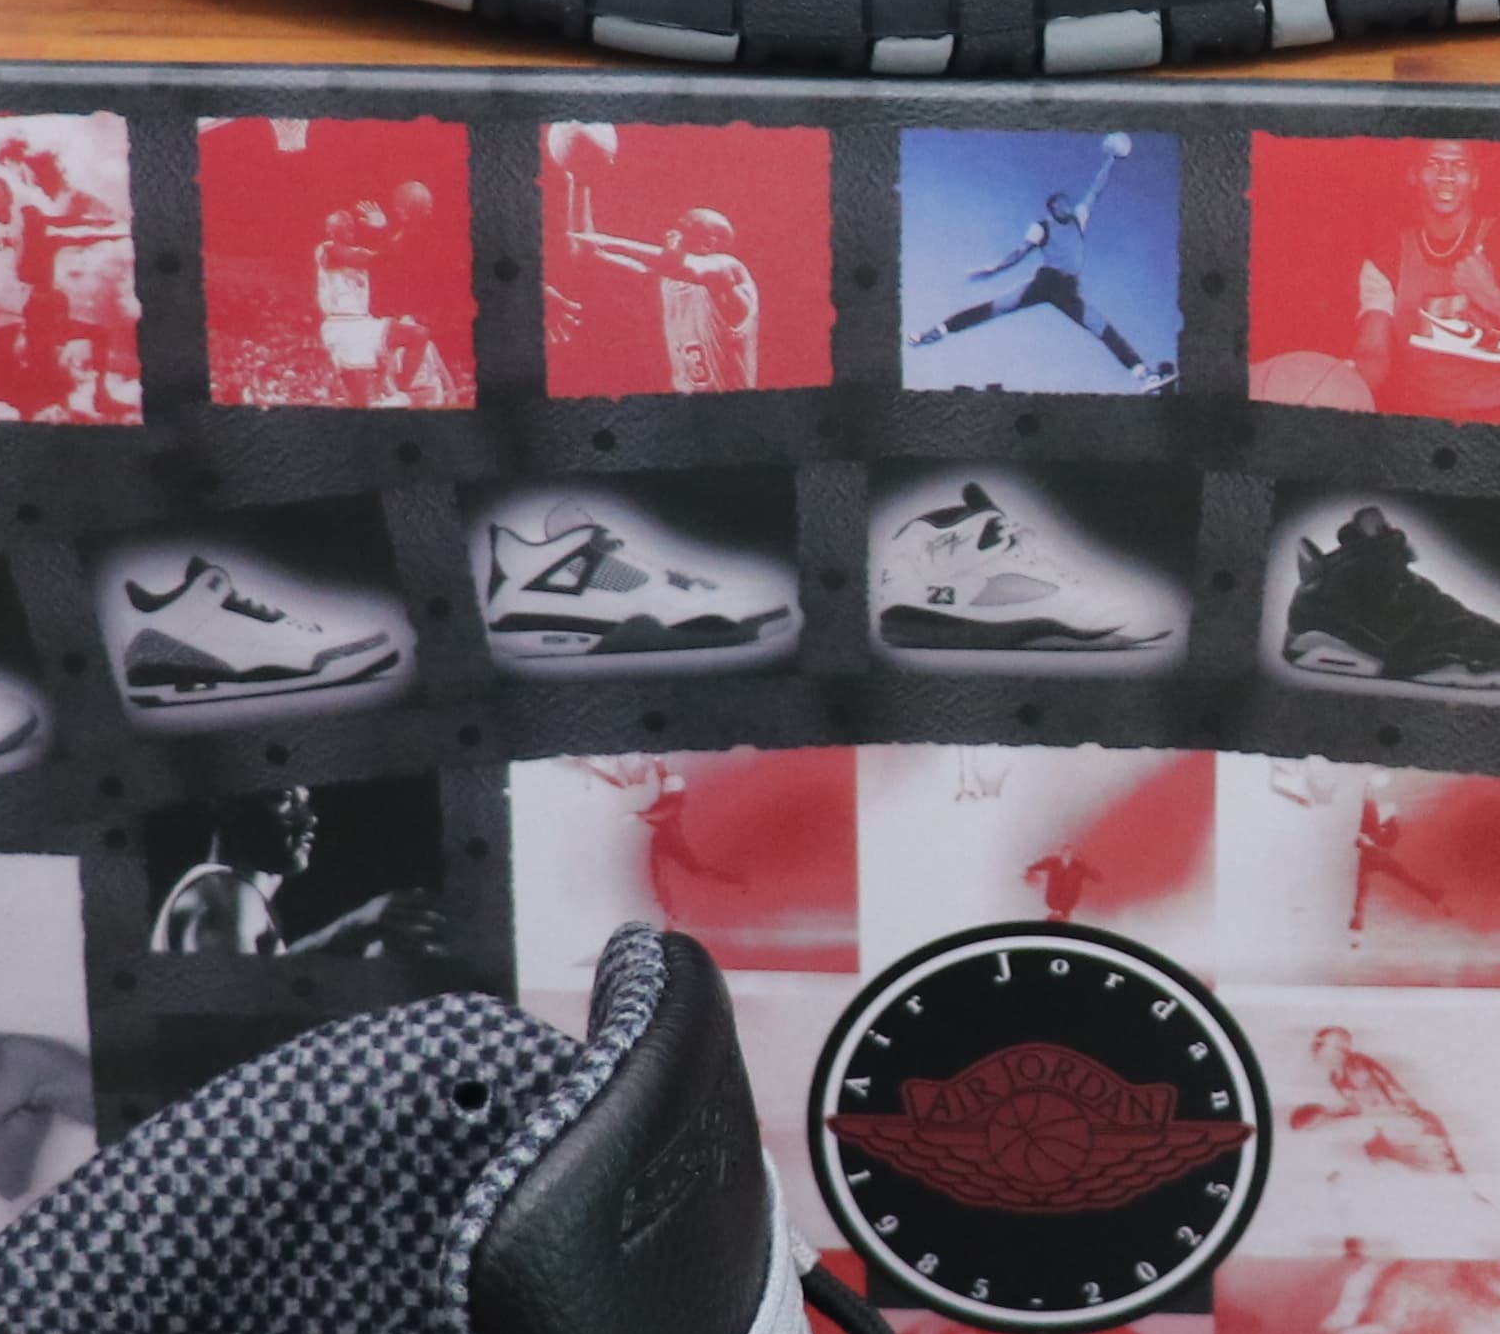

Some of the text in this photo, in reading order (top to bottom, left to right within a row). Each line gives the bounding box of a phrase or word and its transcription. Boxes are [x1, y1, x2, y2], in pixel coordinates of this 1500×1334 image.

[926, 586, 955, 604] 23
[994, 950, 1228, 1110] Jordan
[928, 1049, 1156, 1124] AIR JORDAN
